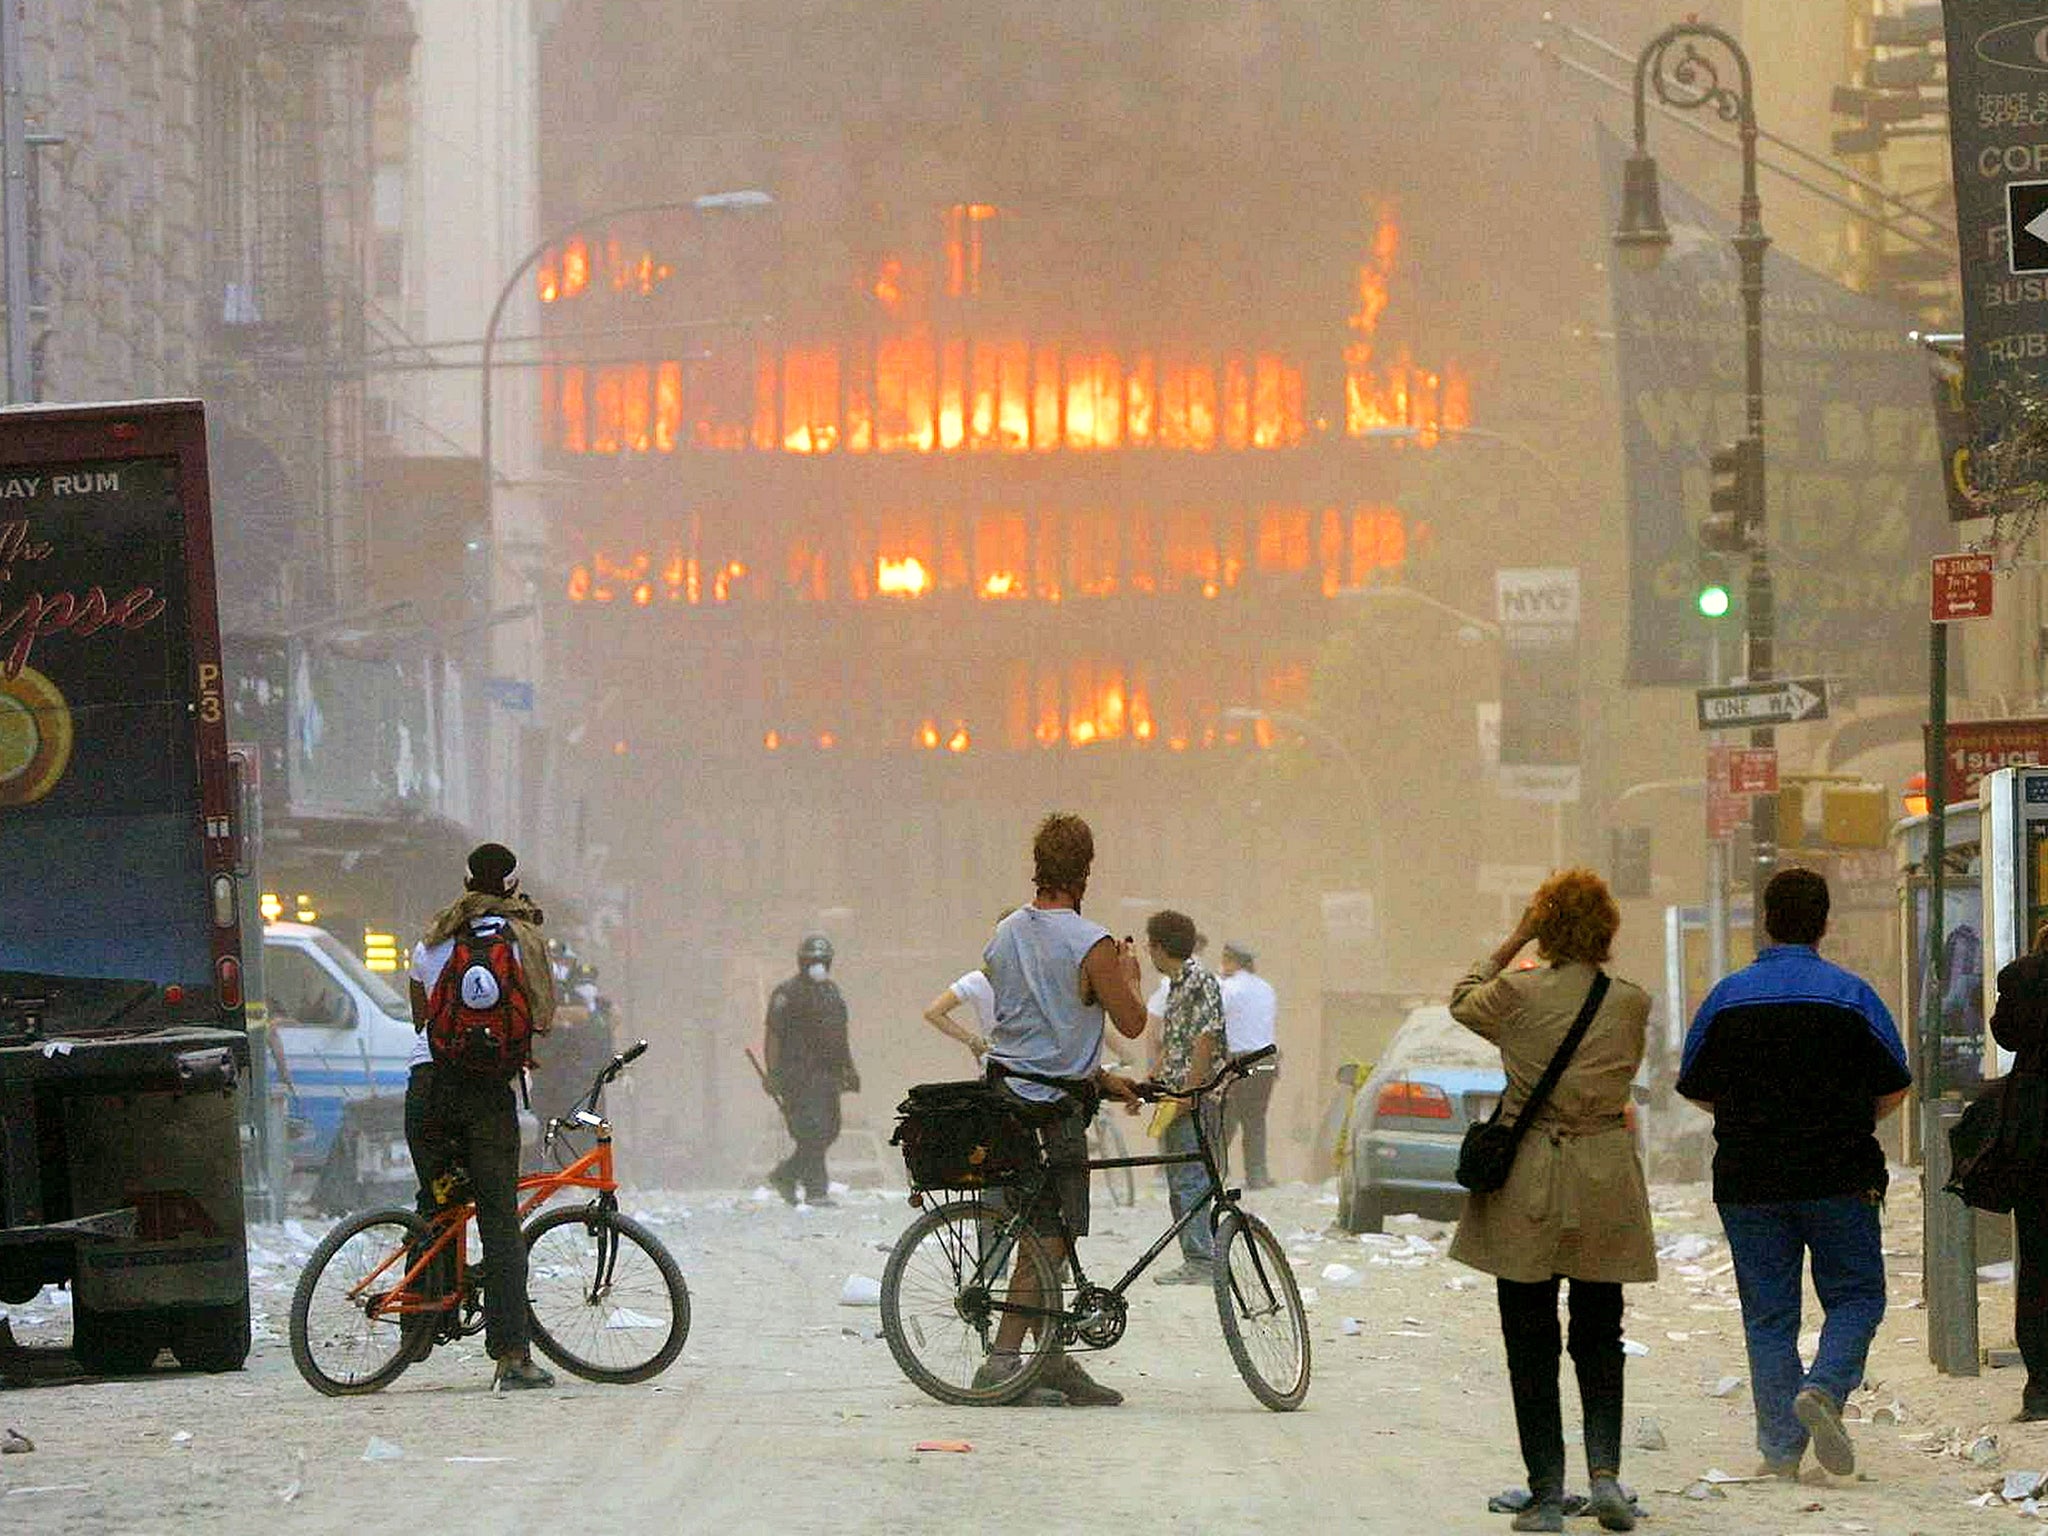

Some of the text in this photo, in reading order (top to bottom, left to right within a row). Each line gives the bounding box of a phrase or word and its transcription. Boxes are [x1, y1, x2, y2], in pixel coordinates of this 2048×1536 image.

[1986, 279, 2048, 307] BUS
[0, 472, 120, 499] AY RUM
[1714, 692, 1808, 716] ONE WAY
